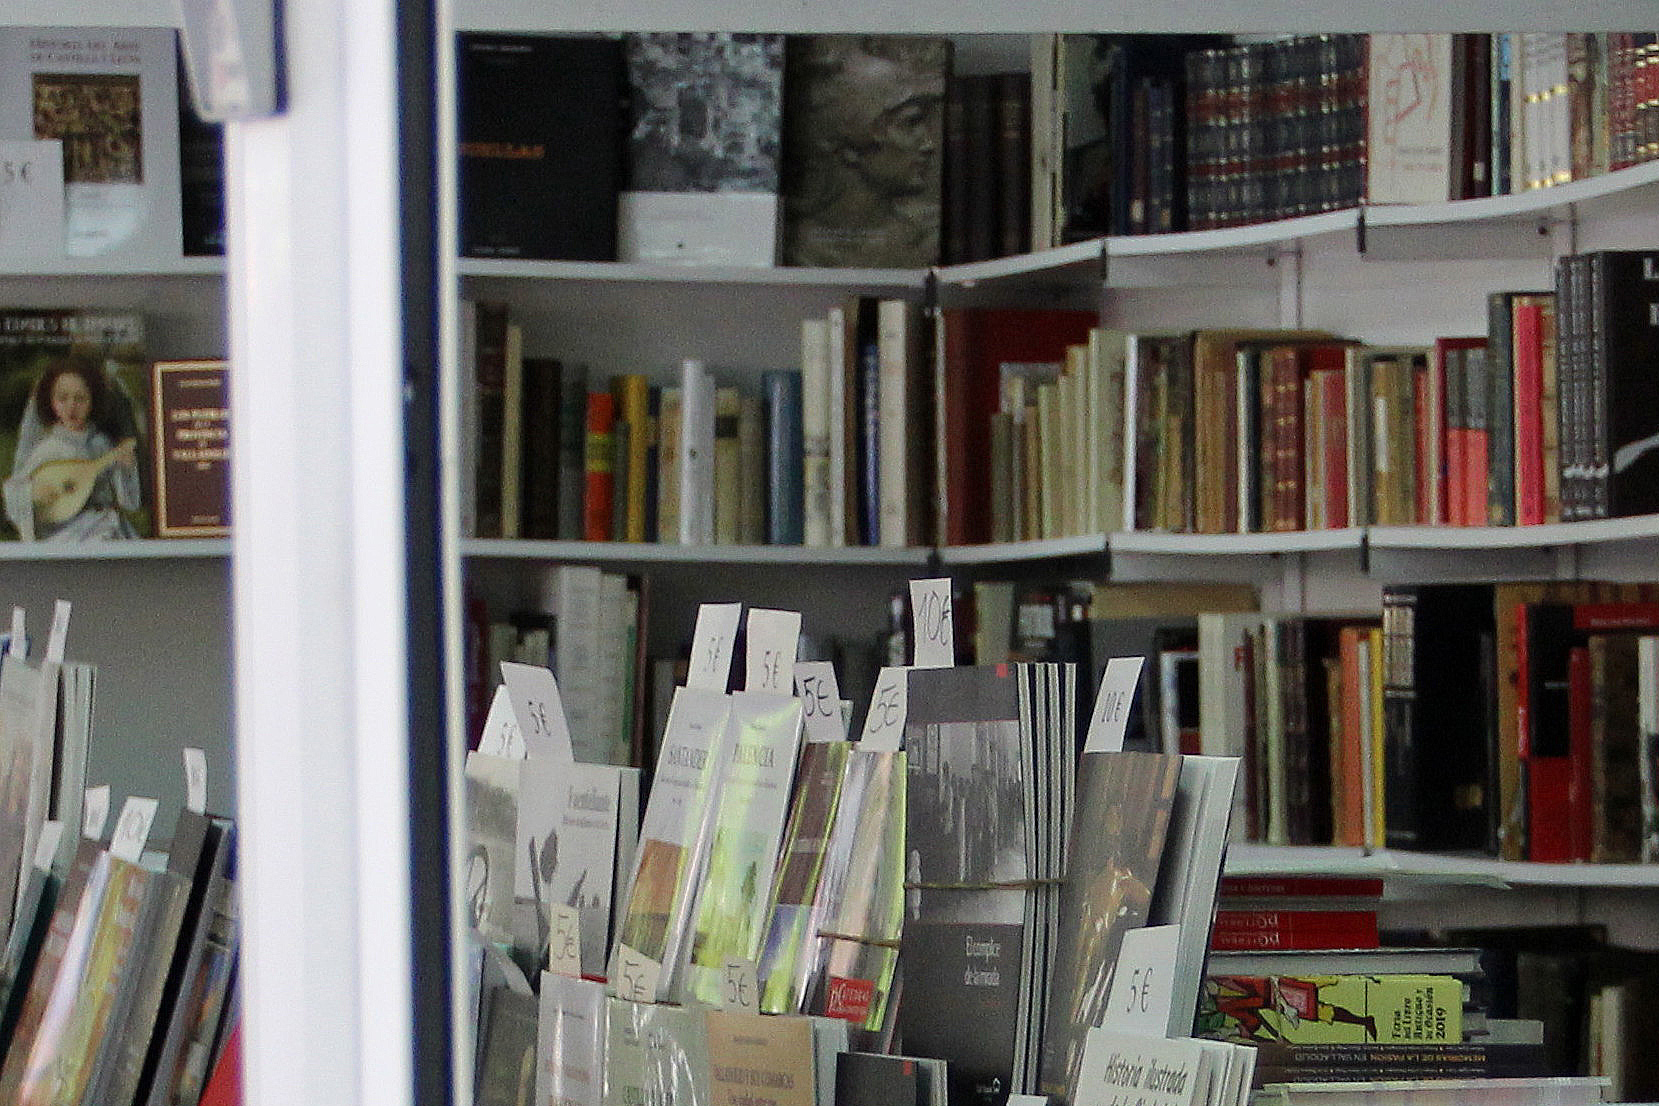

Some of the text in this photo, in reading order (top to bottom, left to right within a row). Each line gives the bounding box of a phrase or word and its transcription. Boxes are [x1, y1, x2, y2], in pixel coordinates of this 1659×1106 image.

[802, 676, 834, 719] 5€
[869, 684, 900, 735] 5€
[1434, 1007, 1447, 1039] 2019
[1104, 1052, 1144, 1089] Historia
